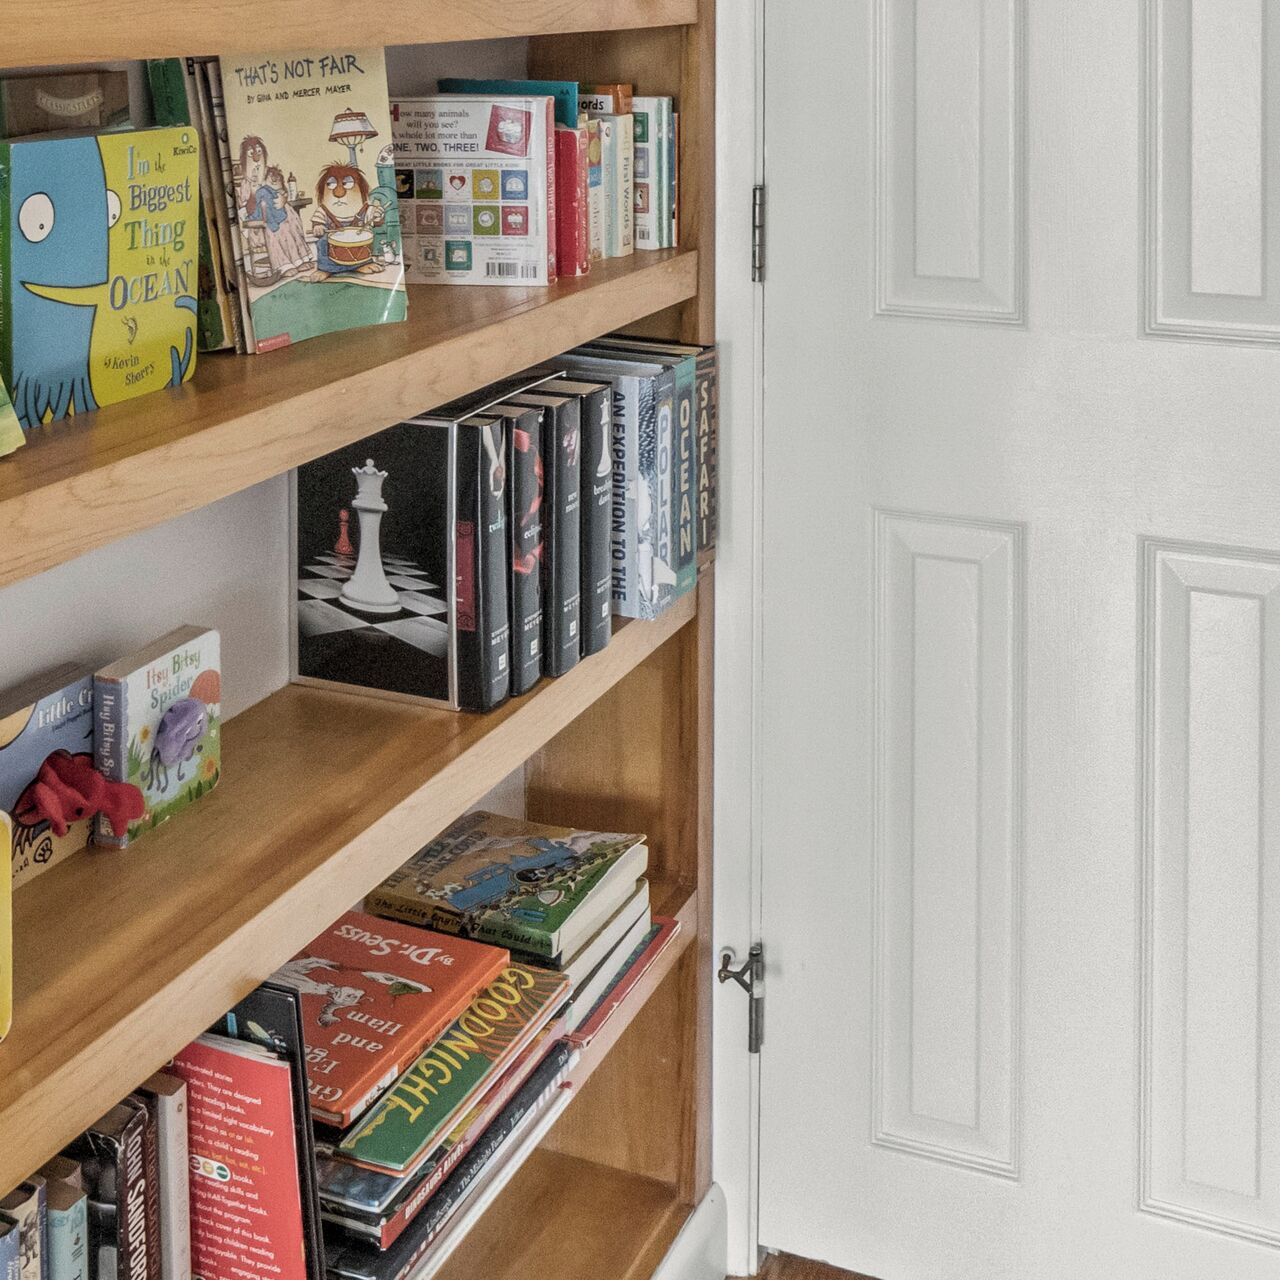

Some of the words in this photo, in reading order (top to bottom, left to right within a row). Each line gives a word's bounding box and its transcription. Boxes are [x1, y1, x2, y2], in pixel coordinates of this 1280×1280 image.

[235, 61, 280, 87] THAT'S
[284, 58, 315, 81] NOT
[319, 54, 365, 77] FAIR
[246, 95, 255, 104] BY
[256, 93, 272, 103] GINA
[275, 91, 289, 101] AND
[293, 87, 321, 98] MERCER
[325, 84, 352, 95] MAYER
[579, 98, 604, 111] ords
[414, 111, 435, 121] many
[438, 109, 470, 118] animals
[128, 176, 192, 212] Biggest
[124, 219, 186, 252] Thing
[109, 258, 194, 311] OCEAN
[111, 354, 141, 371] Kevin
[125, 361, 156, 386] Sherry
[613, 391, 626, 417] AN
[699, 380, 709, 545] SAFARI
[612, 425, 626, 533] EXPEDITION
[680, 399, 691, 556] OCEAN
[613, 539, 626, 562] TO
[612, 567, 627, 601] THE
[151, 676, 193, 711] Spider
[333, 924, 401, 956] Seuss
[398, 944, 443, 965] Dr.
[346, 1010, 405, 1036] Ham
[331, 1032, 384, 1053] and
[390, 966, 536, 1124] GOODNIGHT
[233, 1090, 262, 1105] designed
[239, 1120, 274, 1137] vocabulary
[128, 1126, 144, 1186] JOHN
